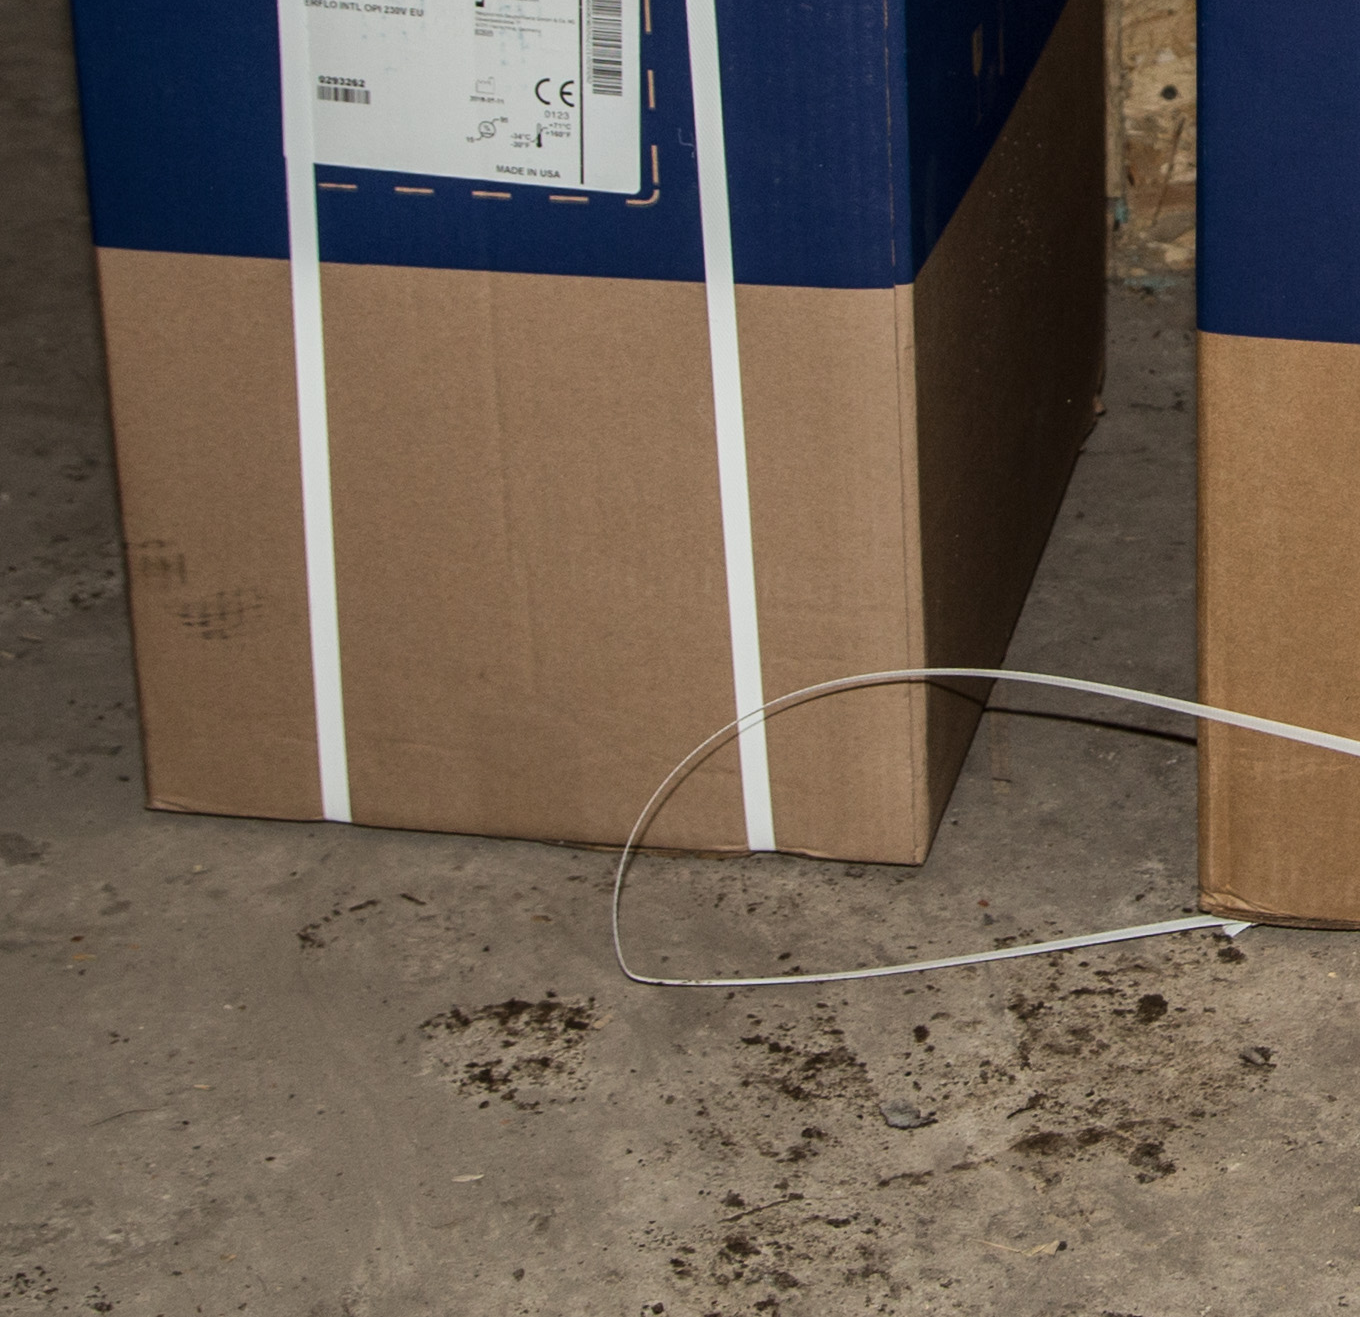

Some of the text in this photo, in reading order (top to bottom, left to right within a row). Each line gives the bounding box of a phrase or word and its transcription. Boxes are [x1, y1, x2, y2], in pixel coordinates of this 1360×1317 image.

[339, 1, 362, 12] INTL
[364, 3, 382, 13] OPI
[384, 5, 407, 16] 230V
[409, 7, 424, 17] EU
[543, 110, 570, 121] 0123
[496, 165, 561, 178] MADE IN USA
